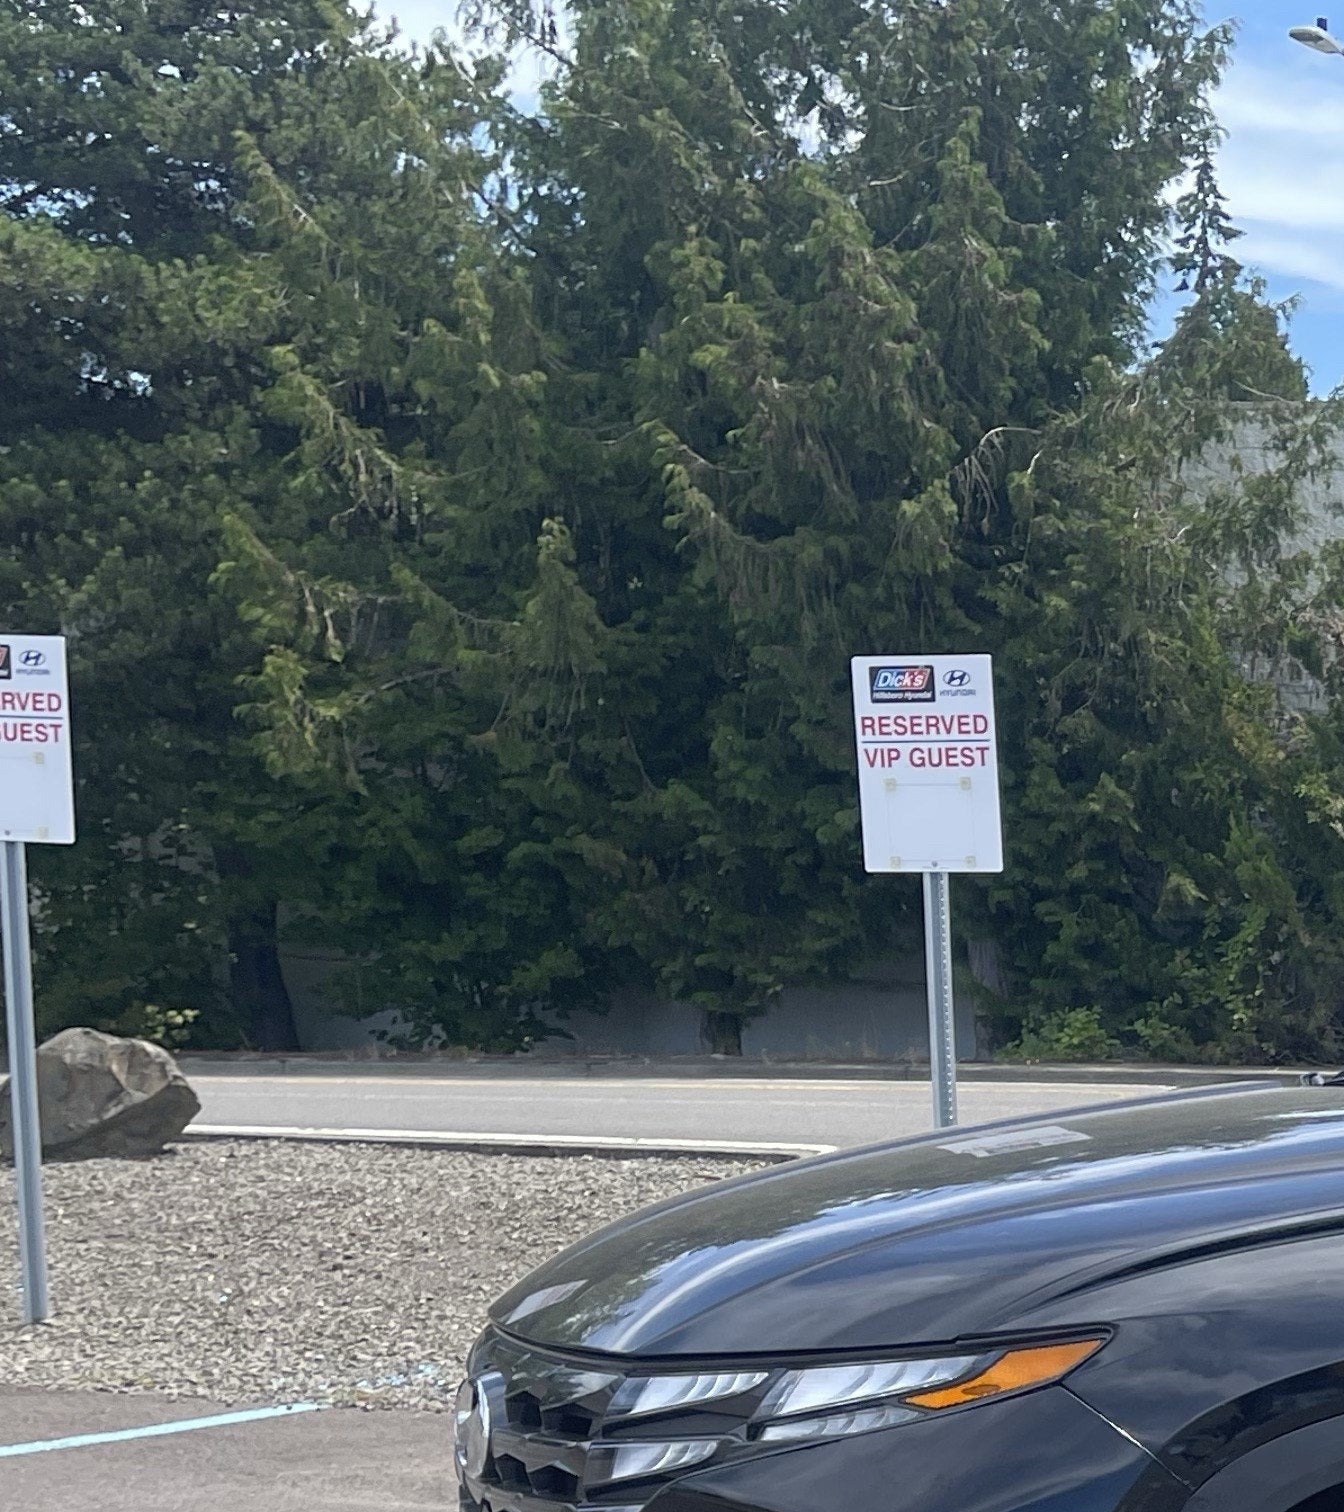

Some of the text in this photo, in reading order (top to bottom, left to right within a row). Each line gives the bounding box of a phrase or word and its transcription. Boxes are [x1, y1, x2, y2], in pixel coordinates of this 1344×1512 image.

[939, 689, 977, 697] HYUNDAI
[0, 722, 63, 743] UEST
[860, 714, 989, 737] RESERVED
[863, 746, 990, 768] VIP GUEST
